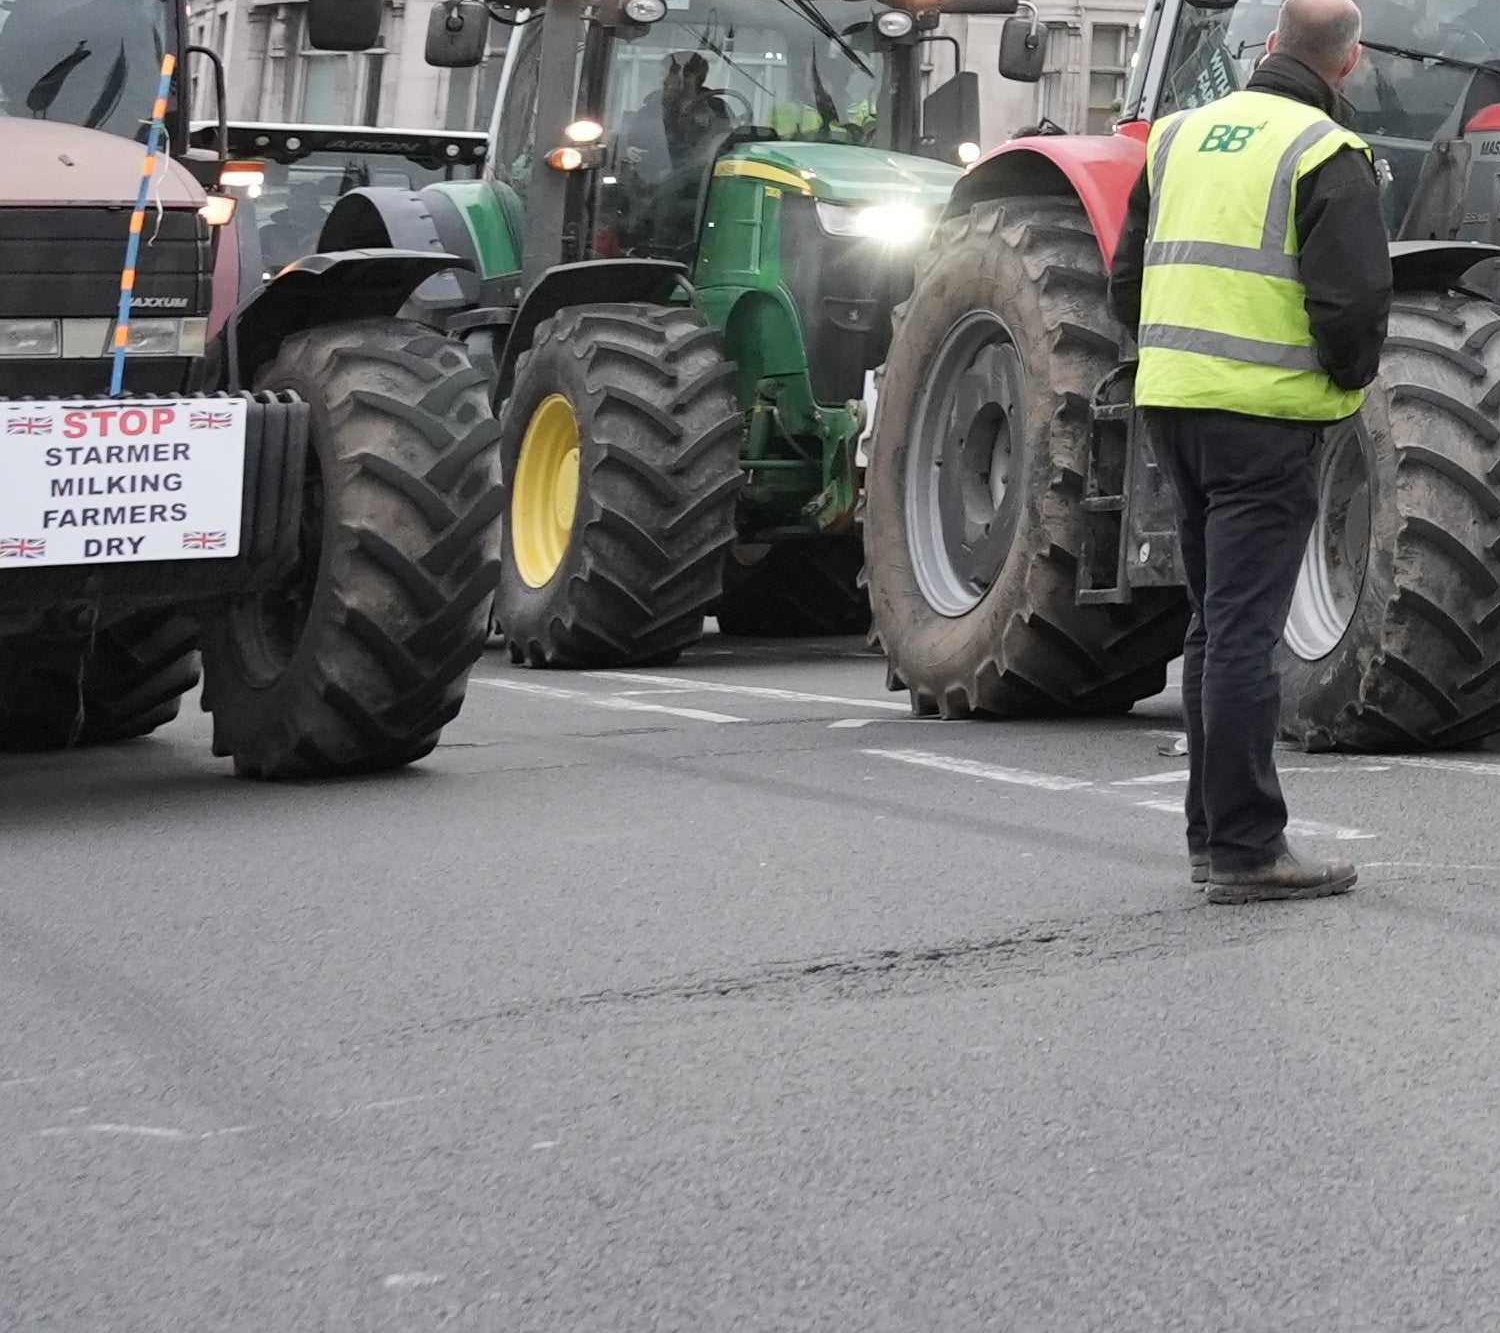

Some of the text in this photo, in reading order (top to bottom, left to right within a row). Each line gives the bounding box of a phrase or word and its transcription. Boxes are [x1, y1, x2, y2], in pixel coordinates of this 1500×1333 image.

[1210, 47, 1231, 98] WITH
[122, 297, 189, 309] AXXUM
[62, 408, 176, 439] STOP
[44, 443, 192, 467] STARMER
[50, 473, 183, 498] MILKING
[42, 503, 188, 529] FARMERS
[83, 536, 147, 559] DRY
